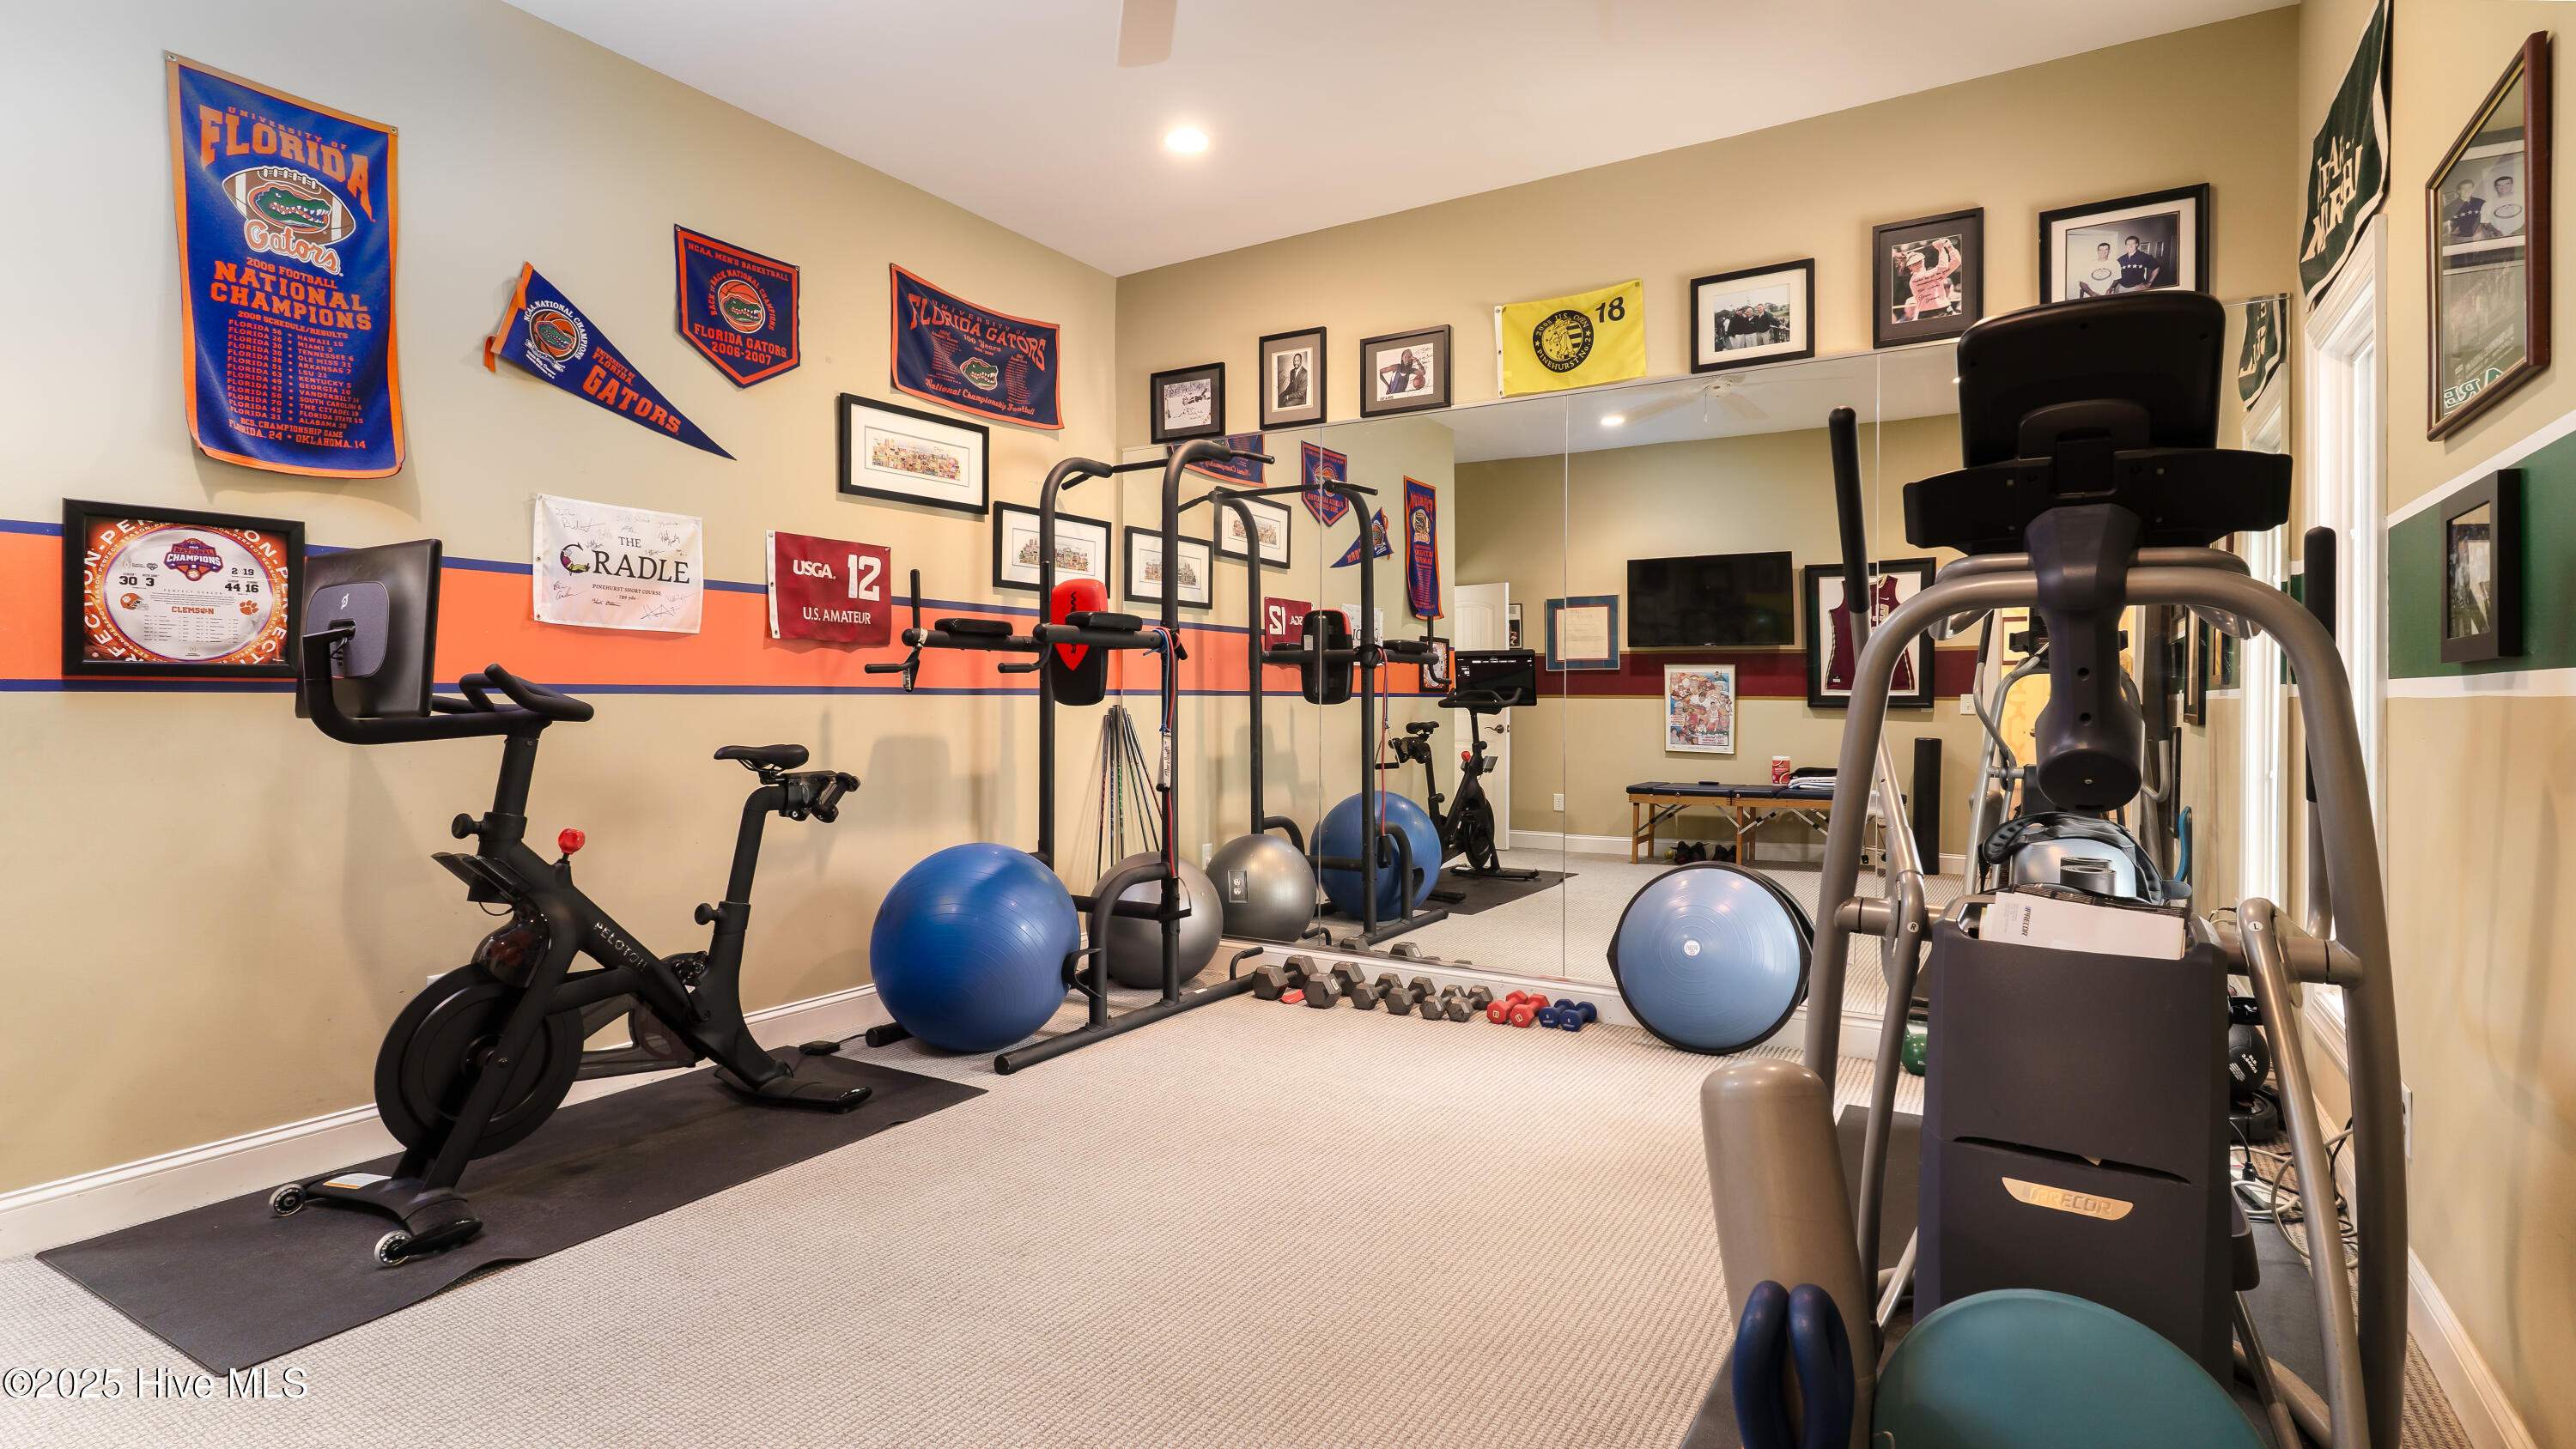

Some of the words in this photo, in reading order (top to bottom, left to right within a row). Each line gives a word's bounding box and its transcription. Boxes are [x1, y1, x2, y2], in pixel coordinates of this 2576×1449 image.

[228, 106, 322, 142] UNIVERSITY
[199, 104, 376, 223] FLORIDA
[244, 218, 341, 275] Gators
[246, 257, 276, 273] 2008
[279, 266, 337, 289] FOOTBALL
[710, 270, 727, 287] BACK
[727, 269, 760, 288] NATIONAL
[741, 261, 789, 282] BASKETBALL
[214, 260, 368, 312] NATIONAL
[210, 282, 372, 330] CHAMPIONS
[708, 294, 718, 316] BACK
[759, 288, 777, 331] CHAMPIONS
[933, 300, 1010, 332] UNIVERSITY
[1595, 296, 1625, 323] 18
[228, 319, 270, 332] FLORIDA
[297, 335, 330, 346] HAWAII
[238, 310, 262, 321] 2008
[263, 316, 349, 339] SCHEDULE/RESULTS
[535, 300, 574, 318] NATIONAL
[574, 318, 588, 360] CHAMPIONS
[908, 293, 981, 336] FLORIDA
[986, 327, 1047, 372] GATORS
[1536, 319, 1552, 336] 2005
[1573, 314, 1589, 329] OPEN
[228, 327, 270, 340] FLORIDA
[297, 341, 325, 351] MIAMI
[228, 334, 270, 347] FLORIDA
[298, 349, 346, 361] TENNESSEE
[694, 323, 743, 347] FLORIDA
[746, 336, 787, 358] GATORS
[963, 335, 976, 344] 100
[978, 339, 1002, 352] Years
[228, 342, 270, 354] FLORIDA
[297, 355, 313, 363] OLE
[228, 349, 270, 361] FLORIDA
[298, 362, 343, 373] ARKANSAS
[228, 356, 269, 368] FLORIDA
[596, 347, 628, 375] UNIVERSITY
[711, 341, 771, 366] 2006-2007
[1537, 349, 1580, 371] PINEHURST
[228, 363, 269, 375] FLORIDA
[298, 376, 343, 387] KENTUCKY
[592, 352, 632, 385] FLORIDA
[227, 371, 269, 383] FLORIDA
[299, 383, 338, 393] GEORGIA
[228, 378, 268, 390] FLORIDA
[299, 390, 351, 402] VANDERBILT
[228, 385, 268, 397] FLORIDA
[299, 397, 324, 405] SOUTH
[228, 392, 268, 404] FLORIDA
[319, 406, 349, 416] CITADEL
[582, 365, 682, 433] GATORS
[926, 378, 961, 396] National
[963, 389, 1006, 410] Championship
[1006, 403, 1036, 415] Football
[228, 399, 268, 411] FLORIDA
[299, 410, 332, 421] FLORIDA
[229, 406, 268, 419] FLORIDA
[299, 417, 337, 428] ALABAMA
[258, 421, 322, 435] CHAMPIONSHIP
[324, 429, 343, 438] GAME
[269, 430, 283, 441] 24
[355, 440, 366, 449] 14
[618, 537, 642, 549] THE
[167, 554, 221, 567] CHAMPIONS
[560, 542, 690, 585] CRADLE
[118, 576, 137, 585] 30
[145, 578, 155, 586] 3
[225, 583, 240, 592] 44
[246, 585, 258, 593] 16
[592, 584, 623, 592] PINEHURST
[793, 559, 834, 579] USGA
[848, 554, 882, 602] 12
[803, 606, 821, 621] U.S.
[823, 609, 871, 625] AMATEUR
[593, 922, 647, 971] PELOTON
[2038, 1190, 2111, 1216] PRECOR
